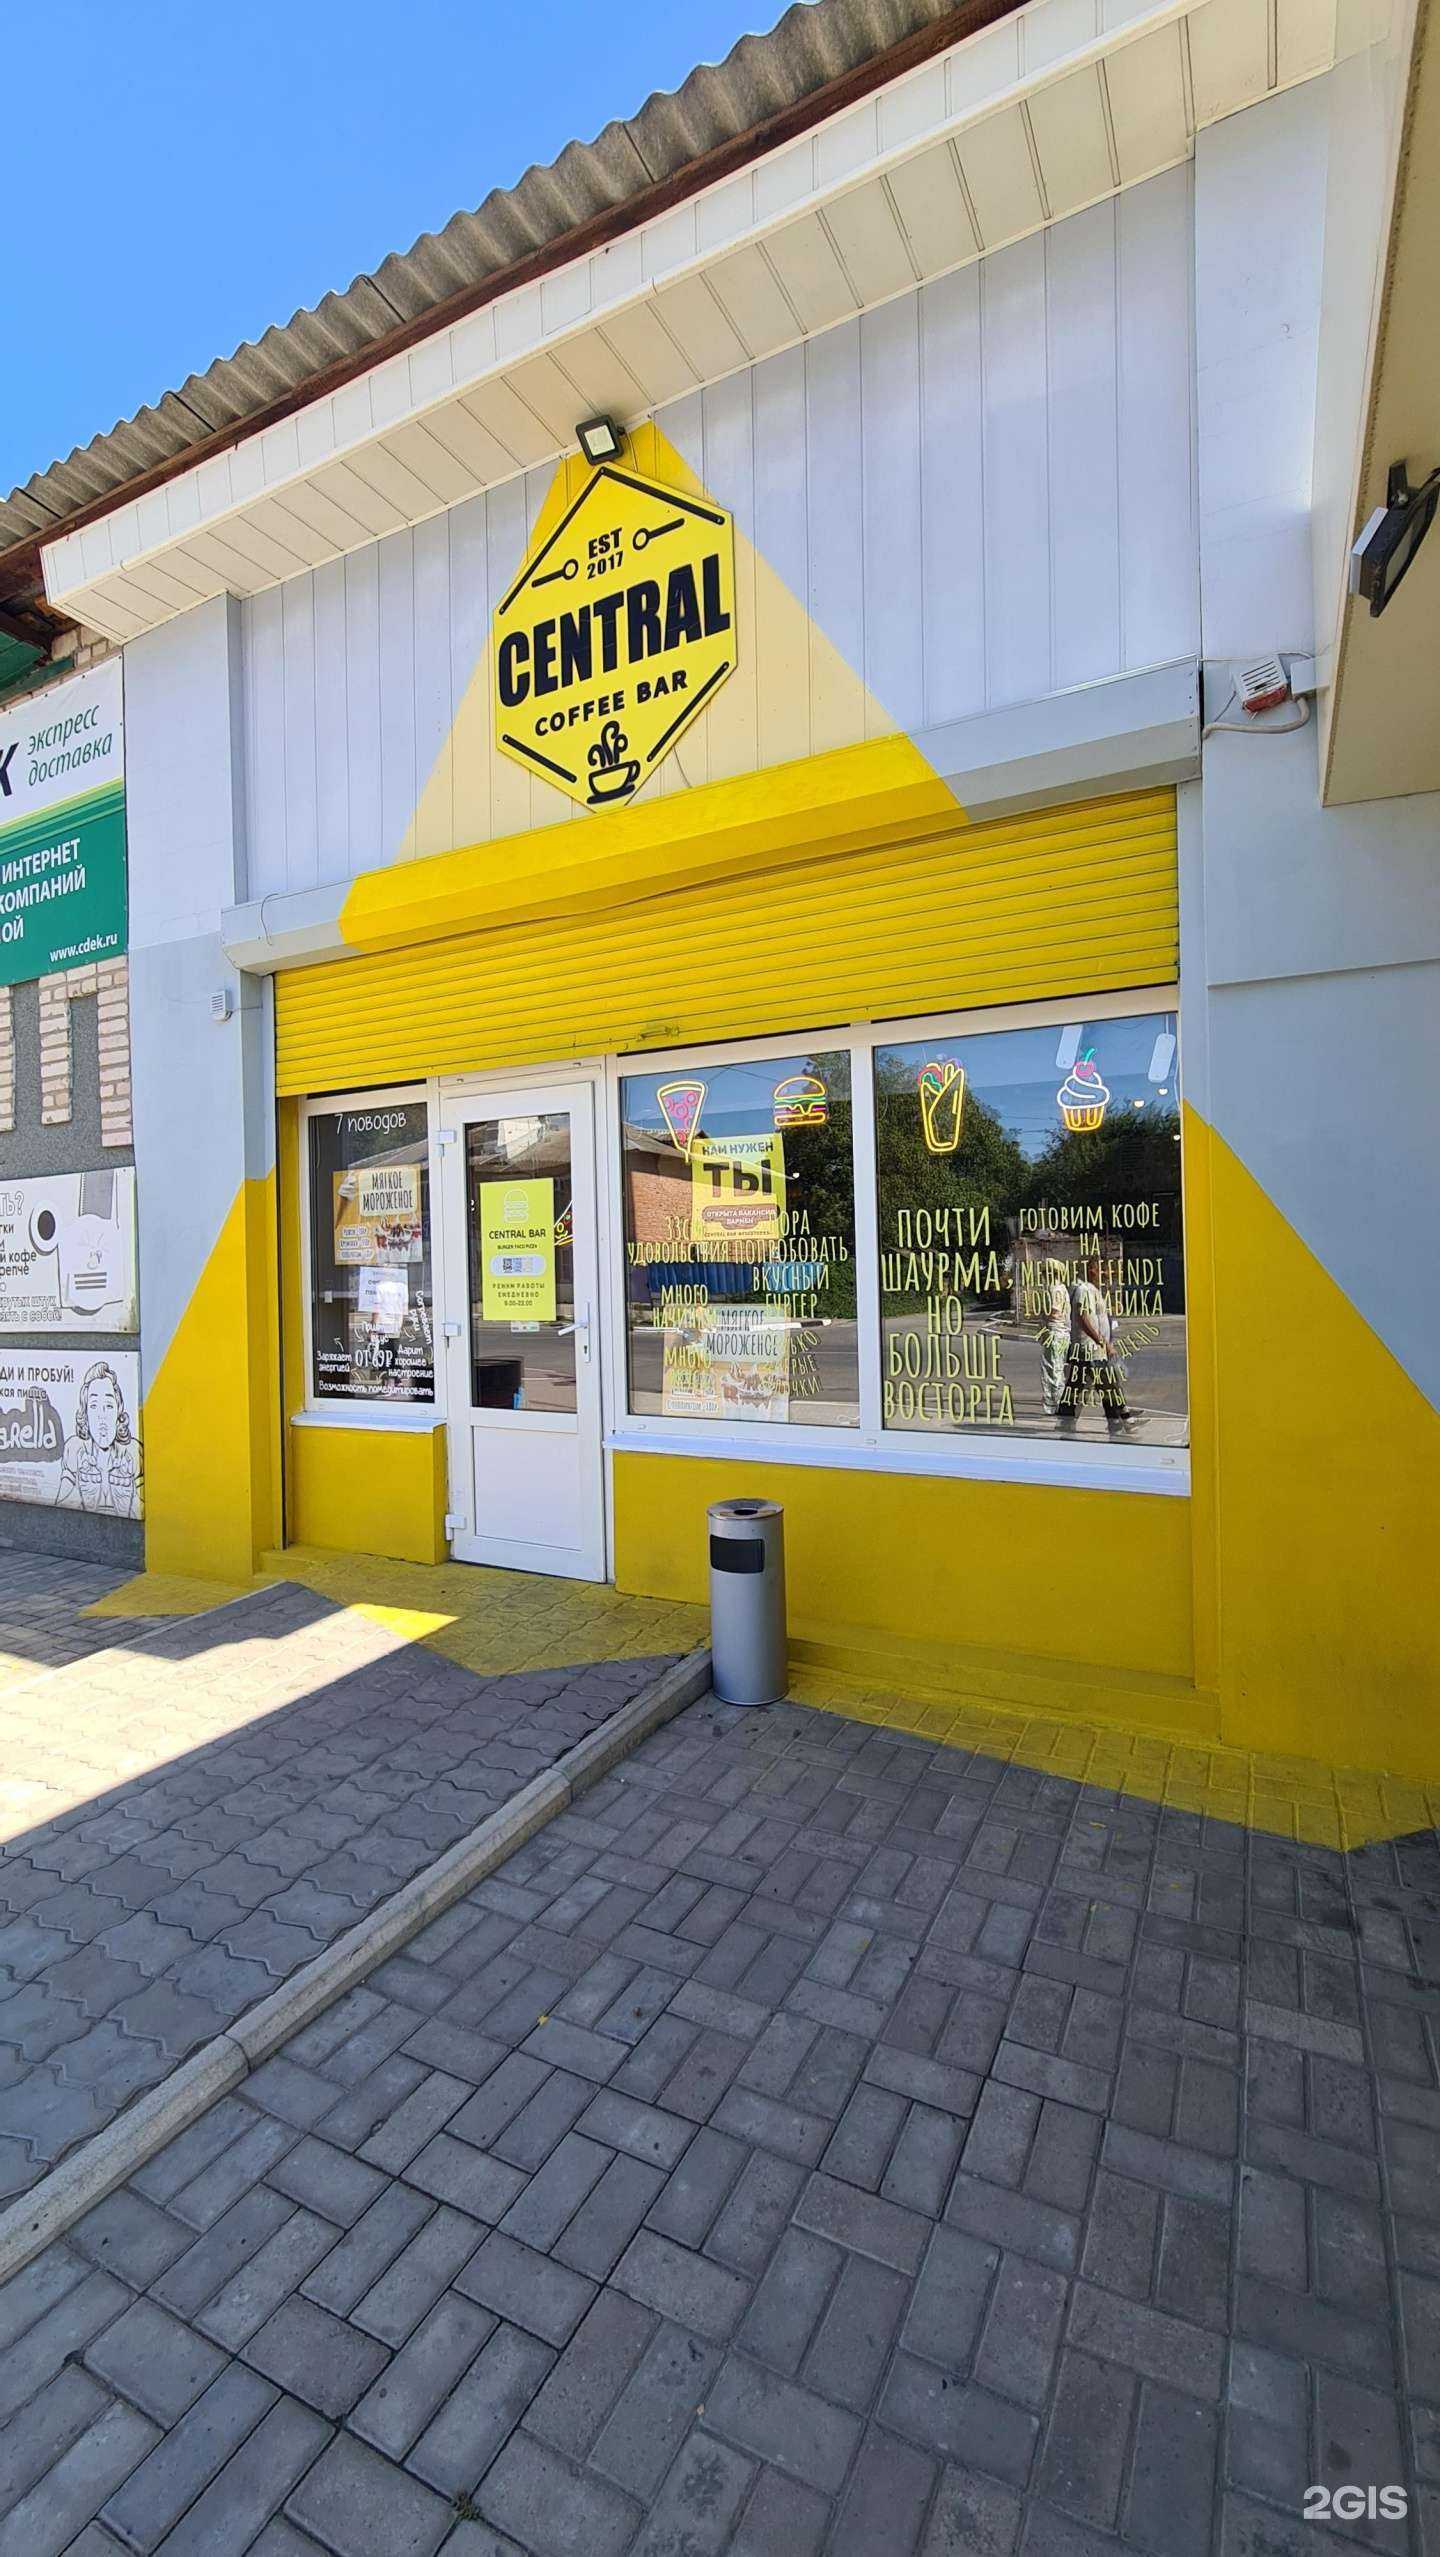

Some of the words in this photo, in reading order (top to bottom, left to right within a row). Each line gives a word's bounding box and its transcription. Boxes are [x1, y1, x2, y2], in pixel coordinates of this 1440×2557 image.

[588, 528, 623, 559] EST
[587, 551, 624, 579] 2017
[498, 553, 731, 707] CENTRAL
[535, 690, 625, 736] COFFEE
[636, 670, 688, 704] BAR
[27, 704, 100, 756] экспресс
[28, 733, 113, 787] доставка
[2, 838, 81, 884] ИНТЕРНЕТ
[0, 864, 86, 914] КОМПАНИЙ
[49, 933, 118, 962] www.cdek.ru
[334, 1113, 344, 1135] 7
[348, 1112, 407, 1135] поводов
[729, 1141, 774, 1153] НУЖЕН
[371, 1171, 403, 1191] МЯГКОЕ
[703, 1159, 773, 1198] ТЫ
[363, 1190, 414, 1212] МОРОЖЕНОЕ
[1020, 1205, 1104, 1231] ГОТОВИМ
[1112, 1201, 1160, 1229] КОФЕ
[488, 1229, 526, 1240] CENTRAL
[528, 1228, 546, 1238] BAR
[897, 1206, 991, 1249] ПОЧТИ
[9, 1248, 37, 1268] кофе
[627, 1240, 729, 1266] УДОВОЛЬСТВИЯ
[735, 1236, 848, 1264] ПОПРОБОВАТЬ
[1080, 1232, 1101, 1257] НА
[881, 1250, 1014, 1293] ШАУРМА,
[1021, 1258, 1089, 1287] MEHMET
[1098, 1257, 1164, 1286] EFENDI
[661, 1284, 709, 1307] МНОГО
[927, 1295, 963, 1335] НО
[706, 1332, 779, 1357] МОРОЖЕНОЕ
[888, 1332, 1004, 1381] БОЛЬШЕ
[1117, 1323, 1161, 1360] ДЕНЬ
[355, 1350, 369, 1368] ОТ
[17, 1366, 25, 1381] И
[27, 1365, 74, 1384] ПРОБУЙ!
[17, 1388, 48, 1400] пицца
[884, 1380, 1015, 1426] ВОСТОРГА
[1060, 1386, 1127, 1408] ДЕСЕРТЫ
